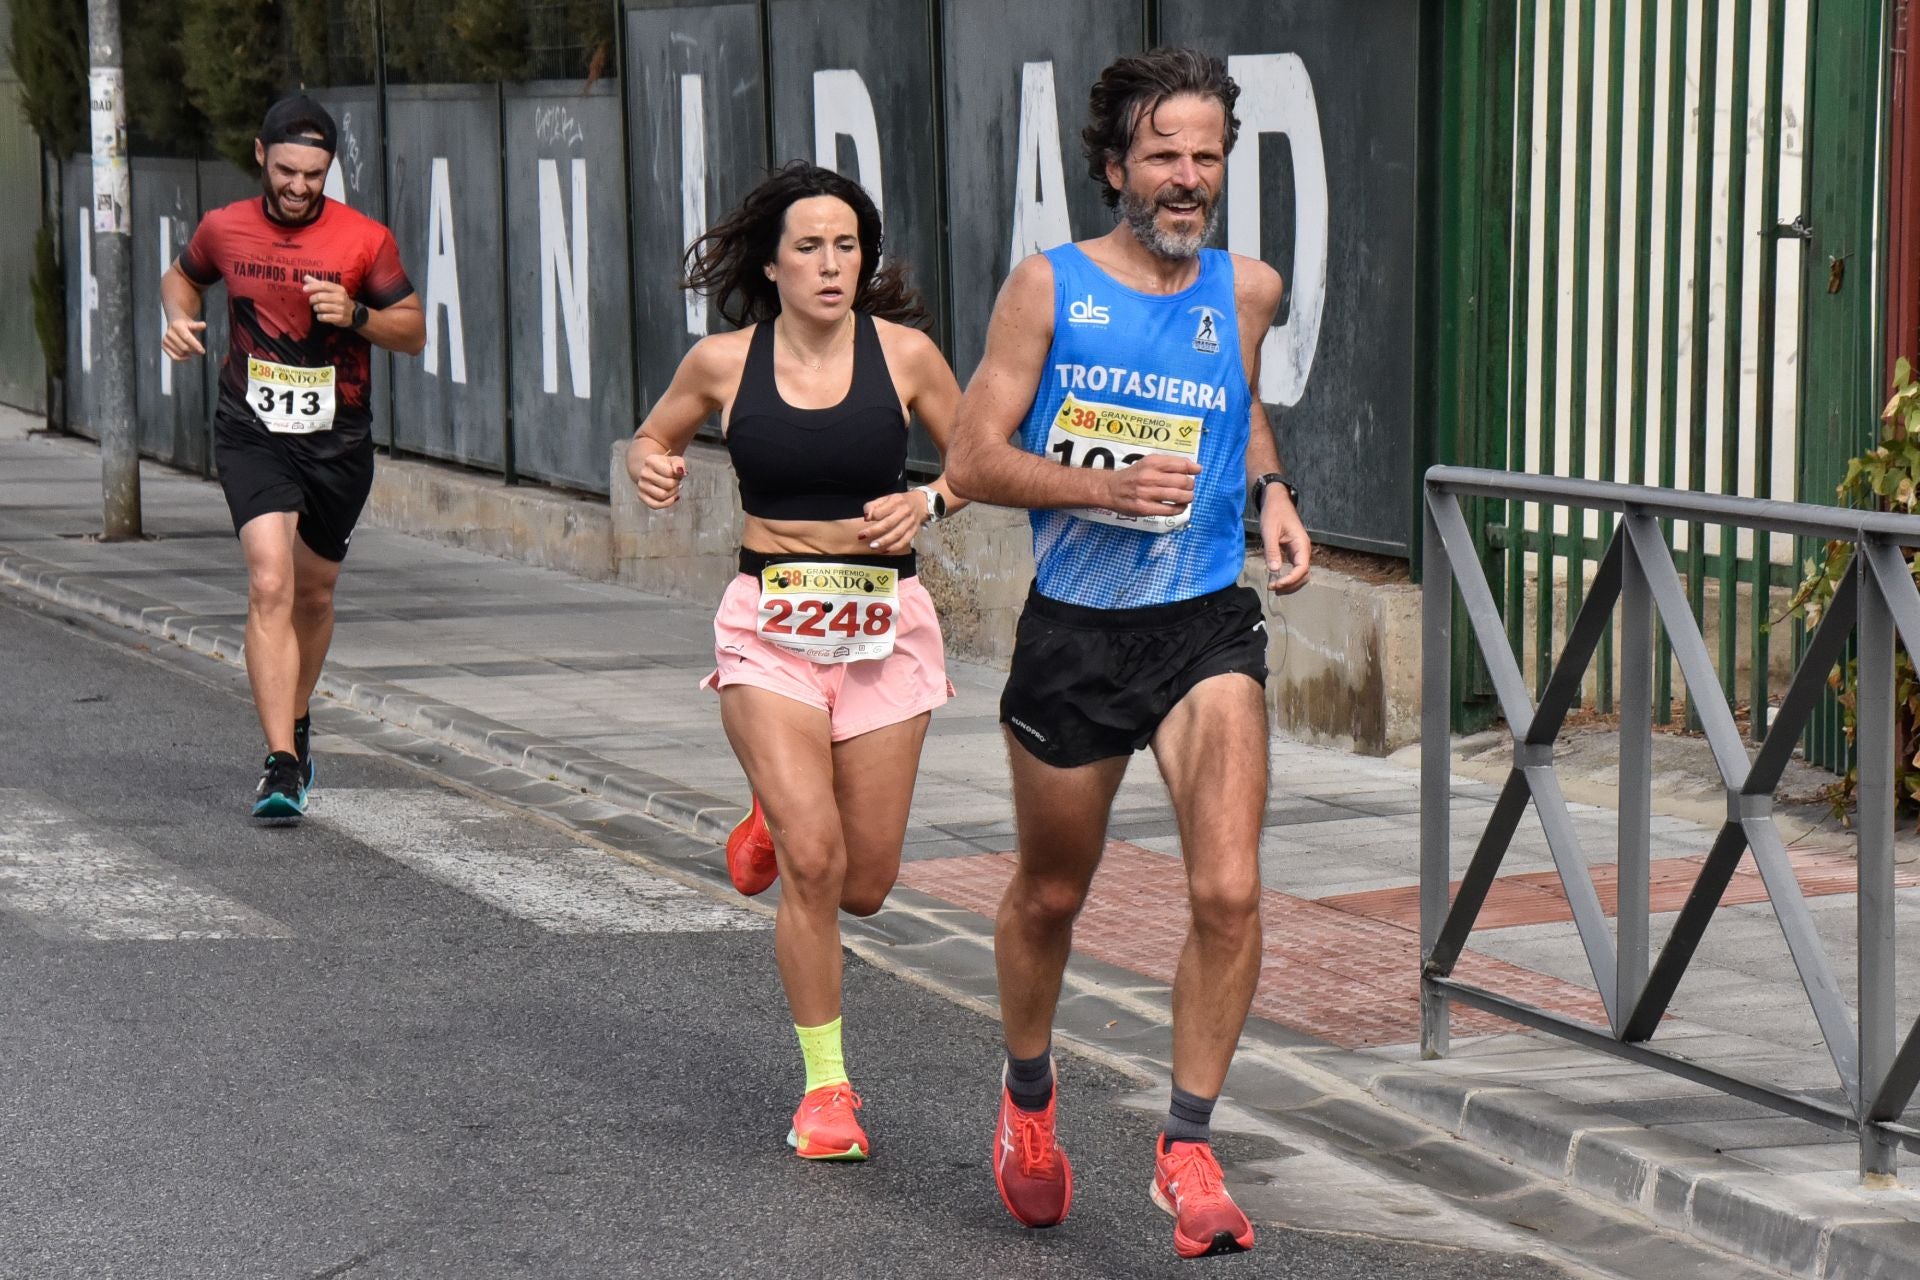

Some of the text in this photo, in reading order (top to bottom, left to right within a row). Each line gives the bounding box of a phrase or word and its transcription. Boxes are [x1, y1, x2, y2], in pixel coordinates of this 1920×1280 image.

[234, 261, 286, 282] VAMPIROS
[258, 364, 317, 384] 38 FONDO
[1055, 364, 1227, 412] TROTASIERRA
[258, 386, 321, 416] 313
[1071, 408, 1096, 429] 38
[1095, 417, 1170, 442] FONDO
[1101, 411, 1128, 421] GRAN
[1130, 416, 1166, 428] PREMIO
[782, 570, 871, 589] 38 FONDO
[806, 568, 831, 576] GRAN
[833, 569, 865, 577] PREMIO
[762, 598, 893, 638] 2248
